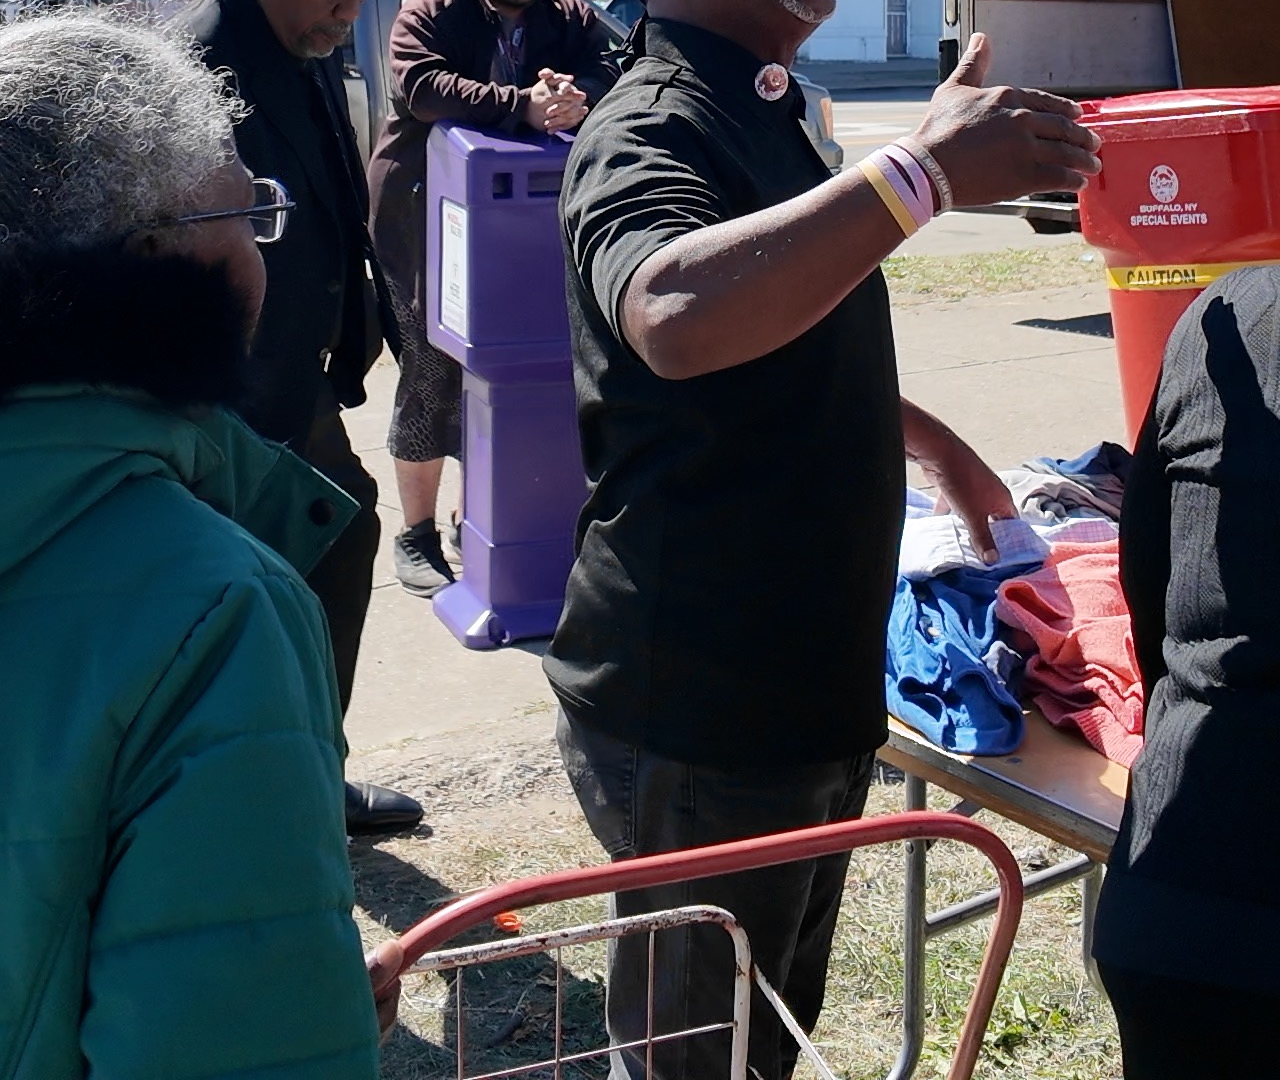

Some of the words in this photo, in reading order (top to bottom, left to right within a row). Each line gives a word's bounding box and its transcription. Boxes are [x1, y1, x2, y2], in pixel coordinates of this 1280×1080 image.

[1184, 202, 1198, 212] NY
[1130, 214, 1170, 226] SPECIAL
[1170, 213, 1208, 225] EVENTS
[1127, 269, 1196, 285] CAUTION
